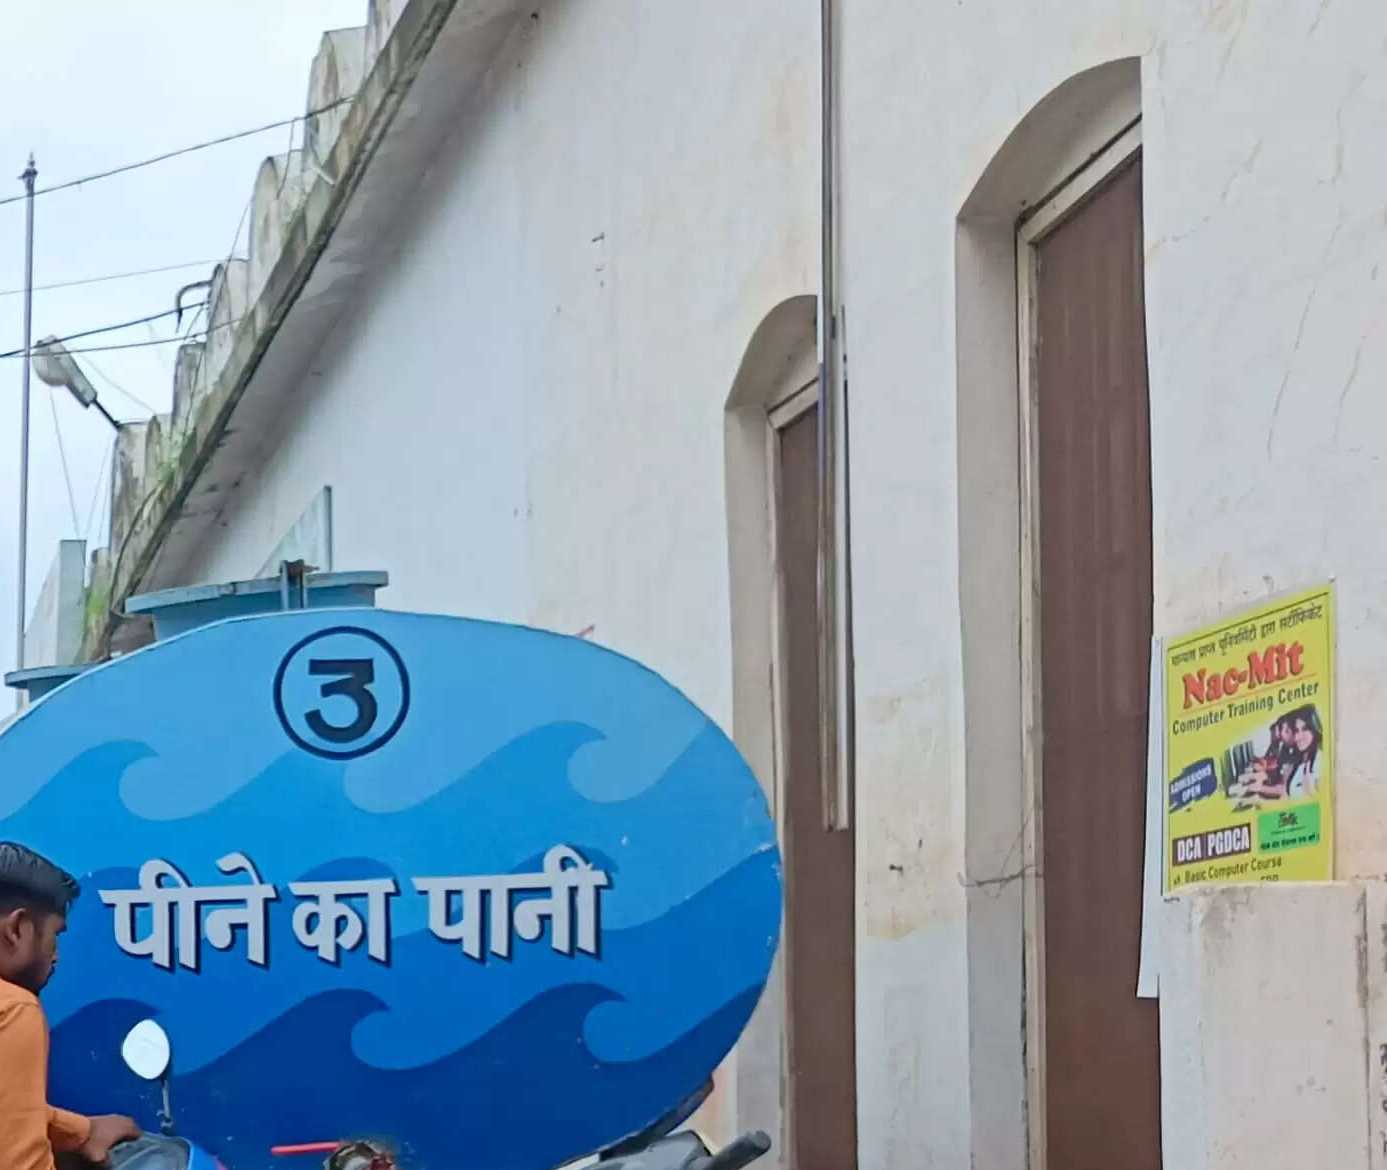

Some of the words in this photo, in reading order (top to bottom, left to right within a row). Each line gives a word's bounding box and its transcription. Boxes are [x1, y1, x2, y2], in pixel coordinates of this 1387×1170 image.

[1182, 641, 1304, 709] Nac-Mit
[1172, 709, 1224, 735] Computer
[1227, 695, 1274, 719] Training
[1278, 682, 1319, 704] Center
[1181, 784, 1201, 802] OPEN
[1177, 835, 1202, 862] DCA
[1207, 826, 1250, 857] PGDCA
[1208, 862, 1248, 881] Computer
[1251, 857, 1282, 873] Course
[100, 852, 278, 971] पीने
[288, 876, 398, 964] का
[412, 844, 609, 960] पानी
